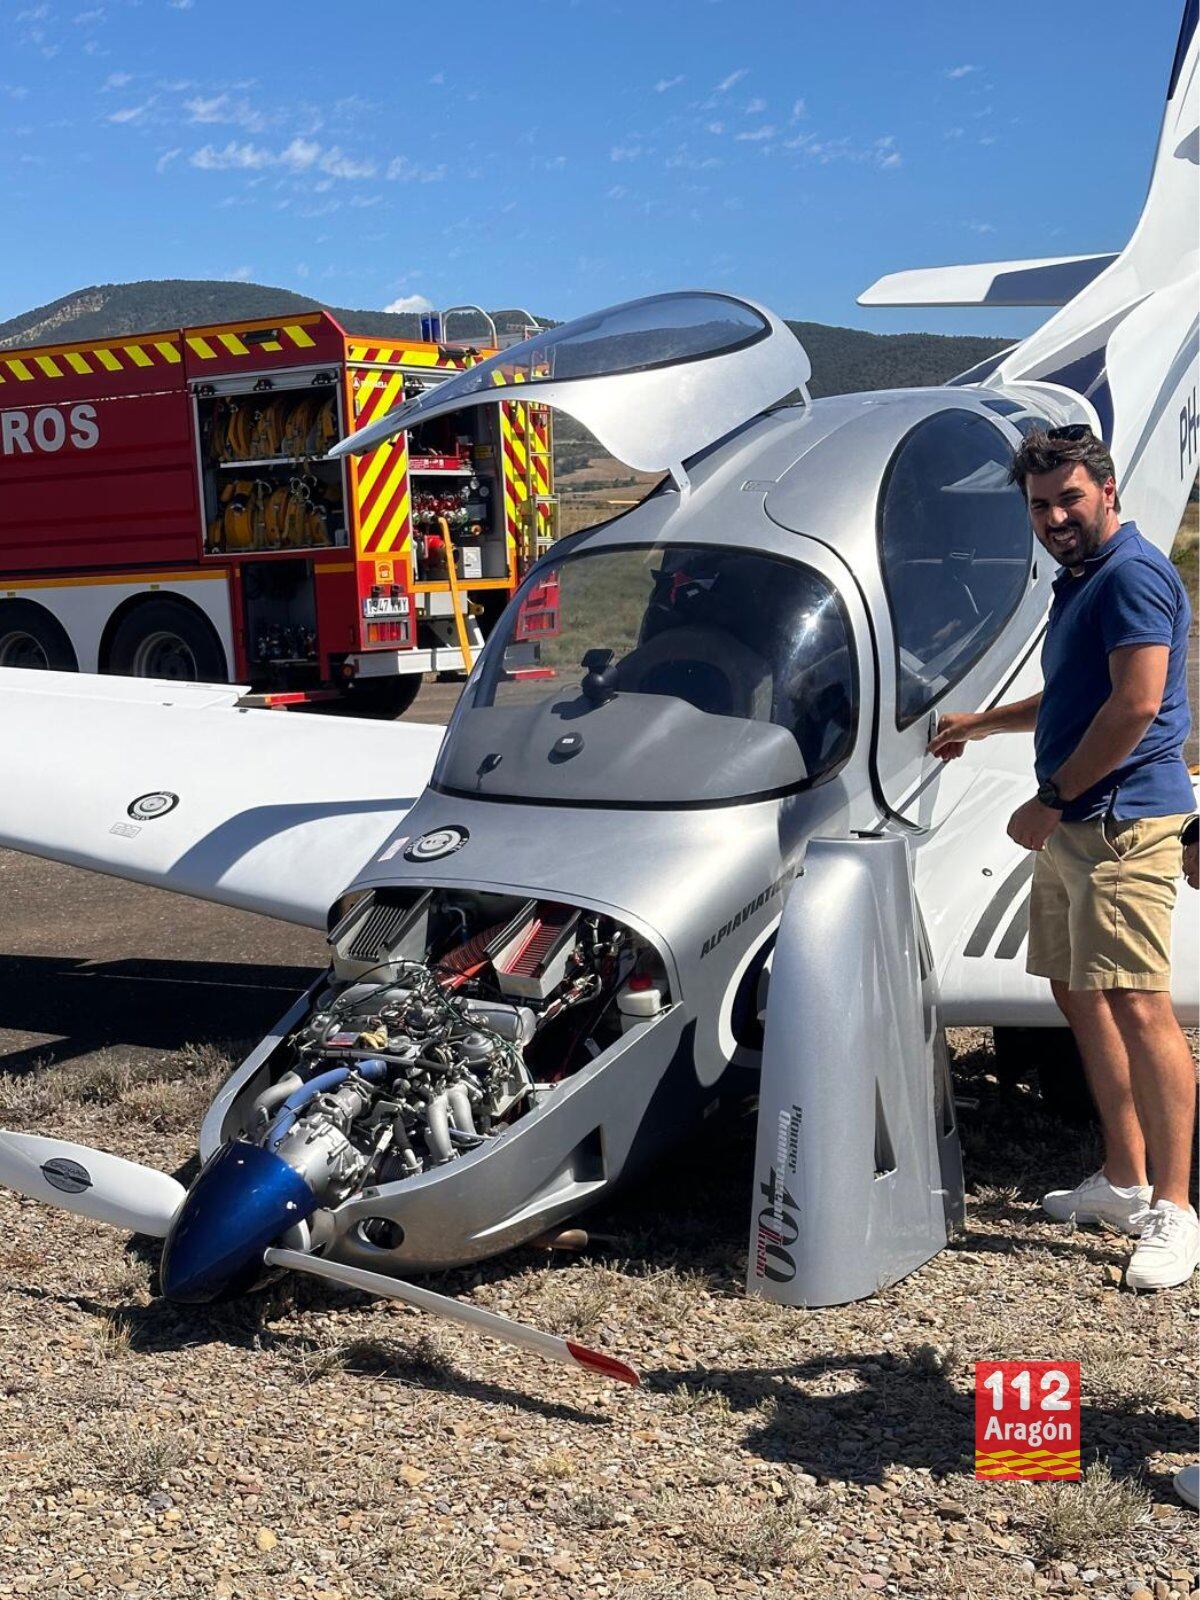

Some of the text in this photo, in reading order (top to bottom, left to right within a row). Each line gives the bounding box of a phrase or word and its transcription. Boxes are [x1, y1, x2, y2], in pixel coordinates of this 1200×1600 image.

[1, 404, 100, 455] ROS
[700, 867, 795, 960] ALPIAVIATI
[789, 1104, 803, 1174] Pioneer
[758, 1166, 802, 1283] 400
